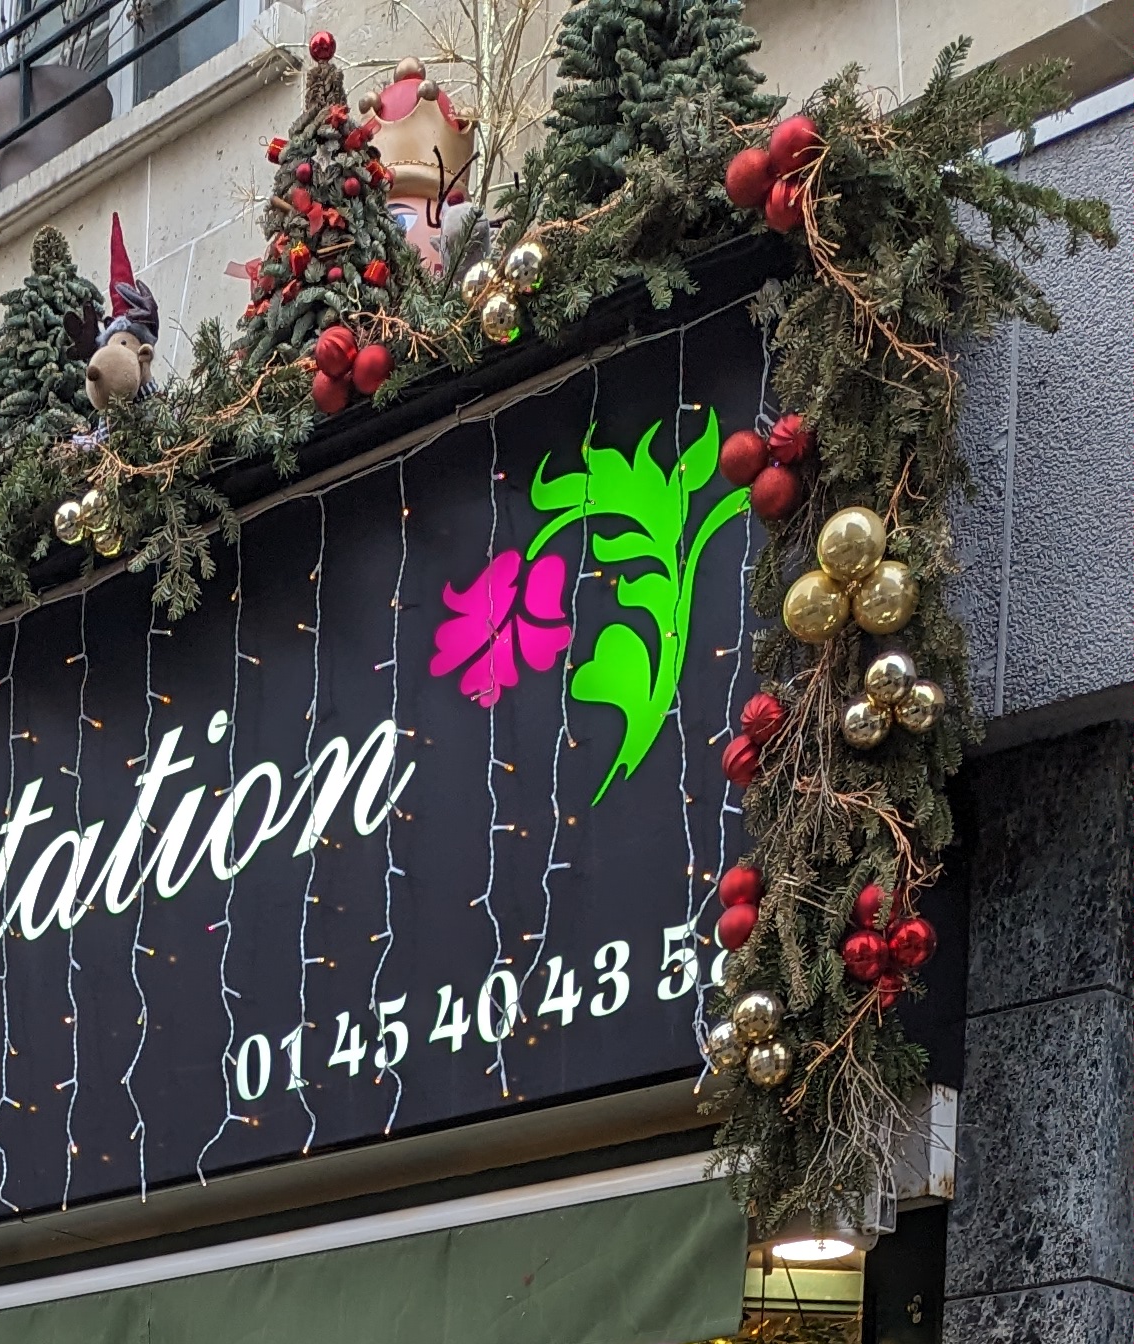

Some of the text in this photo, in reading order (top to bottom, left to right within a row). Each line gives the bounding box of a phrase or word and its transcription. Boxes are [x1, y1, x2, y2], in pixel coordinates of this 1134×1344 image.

[235, 1029, 312, 1102] 01
[326, 990, 409, 1078] 45
[429, 970, 518, 1054] 40
[536, 937, 627, 1030] 43
